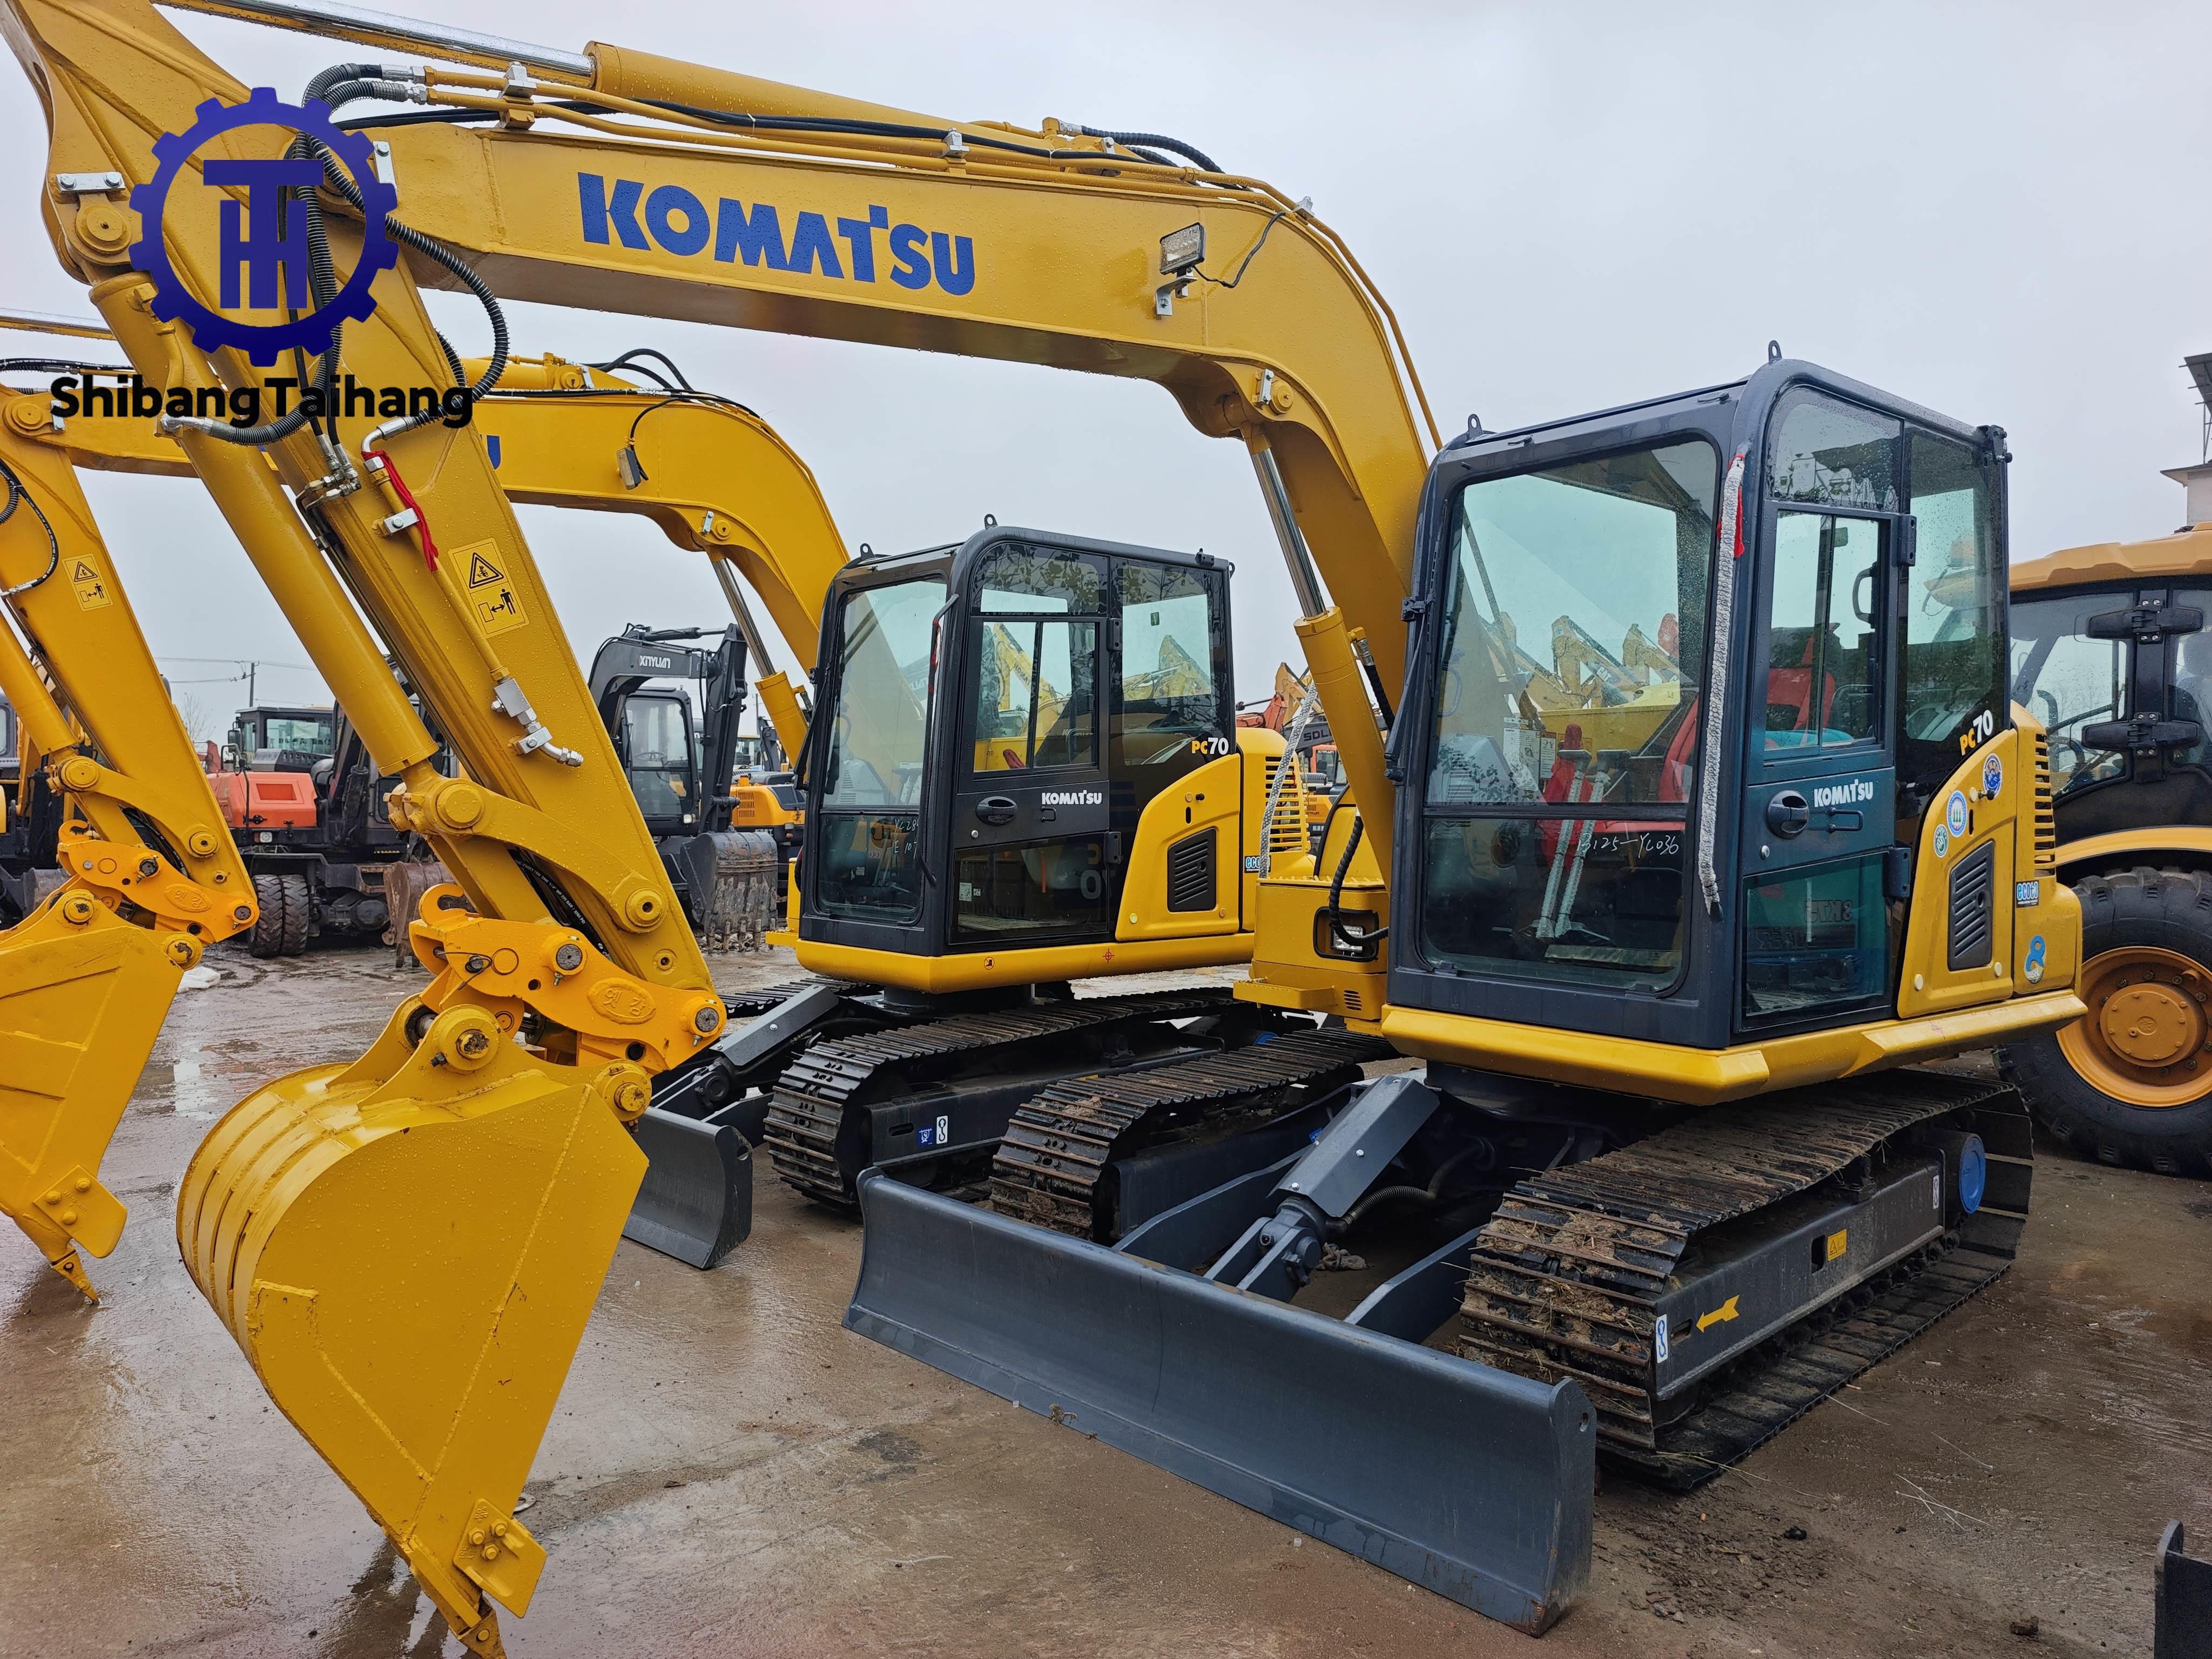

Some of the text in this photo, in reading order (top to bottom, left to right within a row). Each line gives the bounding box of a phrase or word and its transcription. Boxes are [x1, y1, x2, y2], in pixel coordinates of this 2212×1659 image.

[578, 172, 975, 295] KOMATSU
[1192, 738, 1229, 755] PC70
[1960, 710, 1993, 756] PC70
[1041, 790, 1102, 805] KOMATSU
[1814, 778, 1873, 807] KOMATSU
